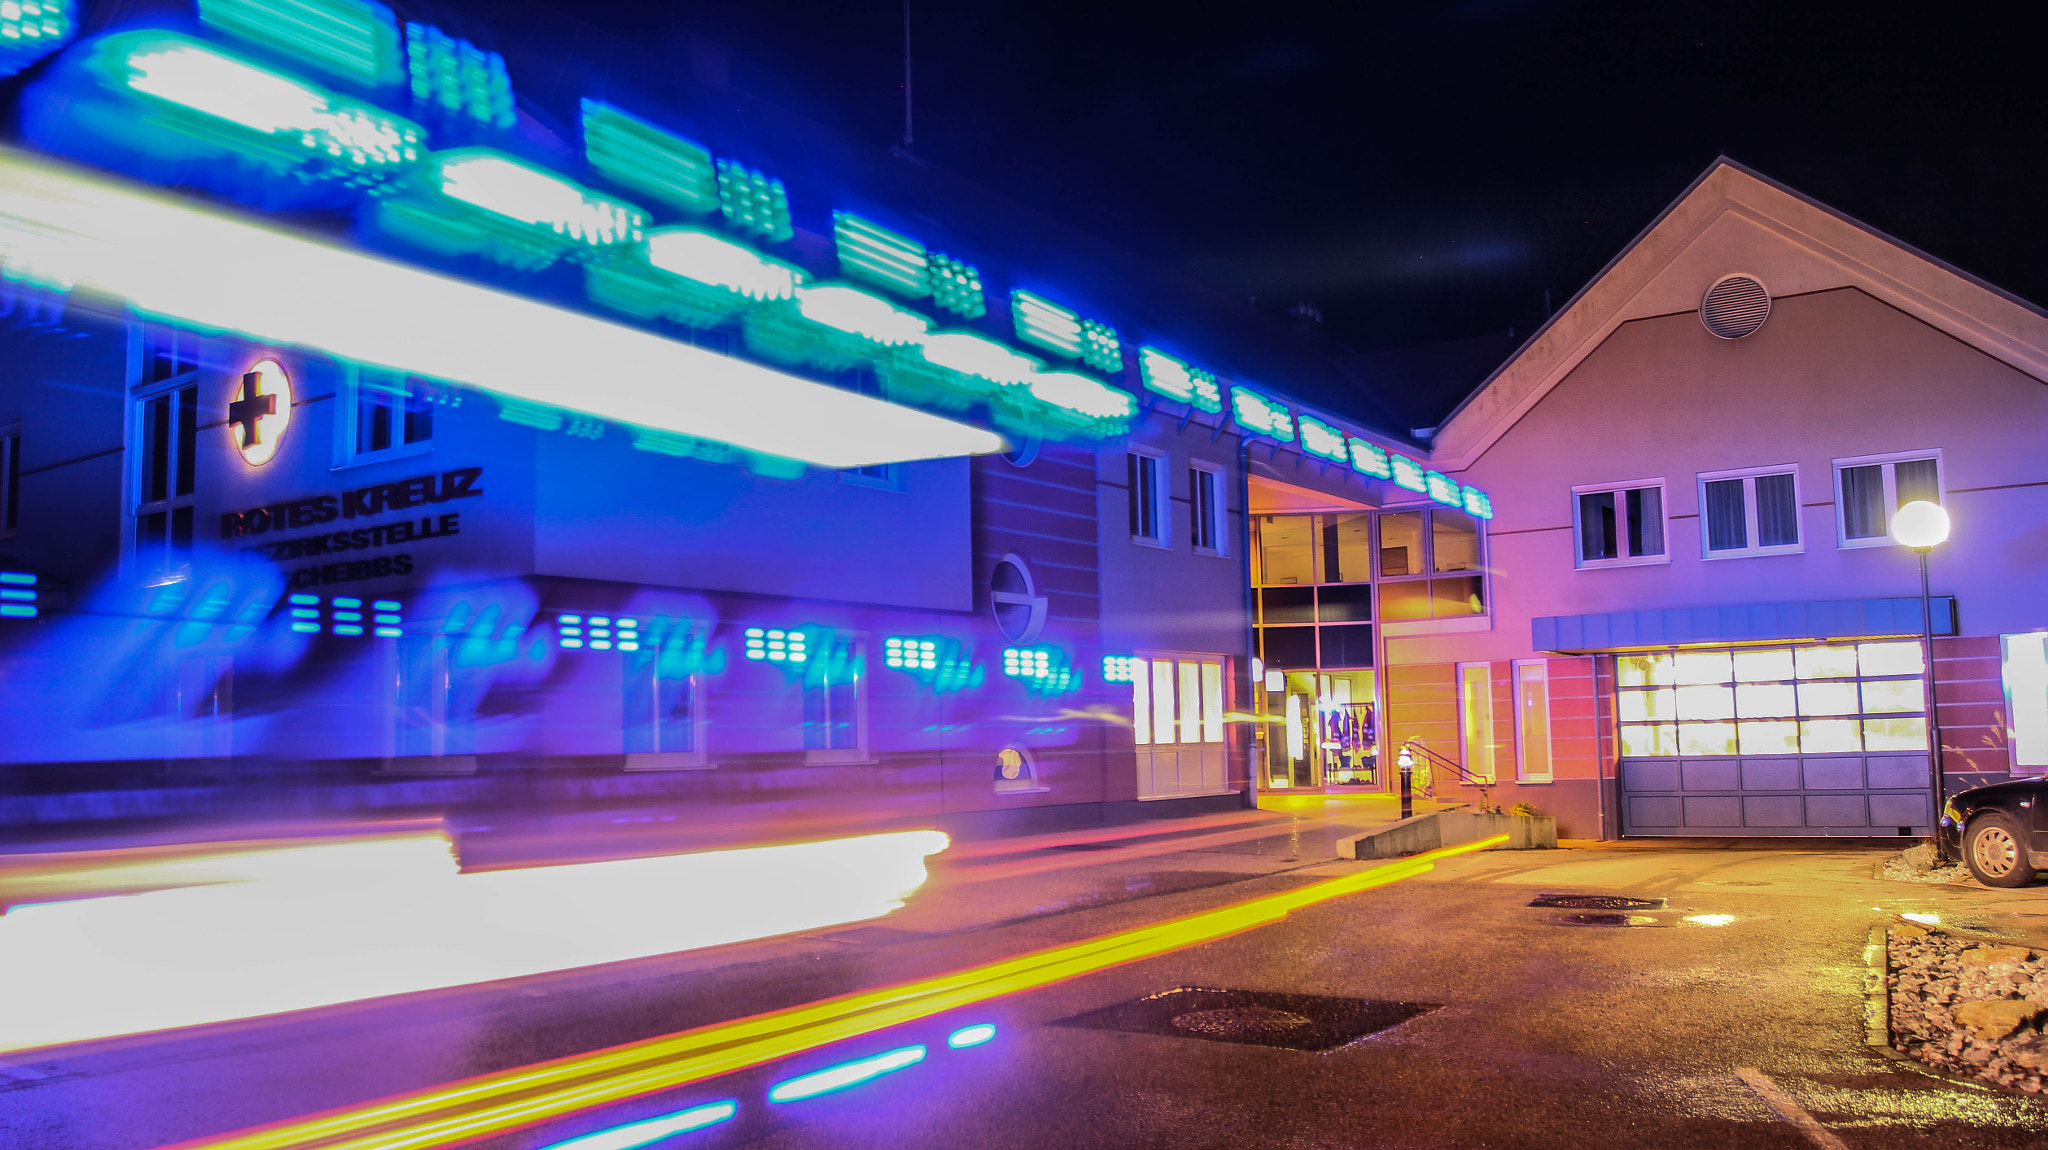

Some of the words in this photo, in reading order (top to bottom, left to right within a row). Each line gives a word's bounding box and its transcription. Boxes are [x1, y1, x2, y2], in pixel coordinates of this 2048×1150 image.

[220, 496, 339, 539] ROTES
[342, 467, 483, 519] KREUZ
[240, 513, 459, 562] EZIRKSSTELLE
[283, 554, 414, 589] CHEIBBS
